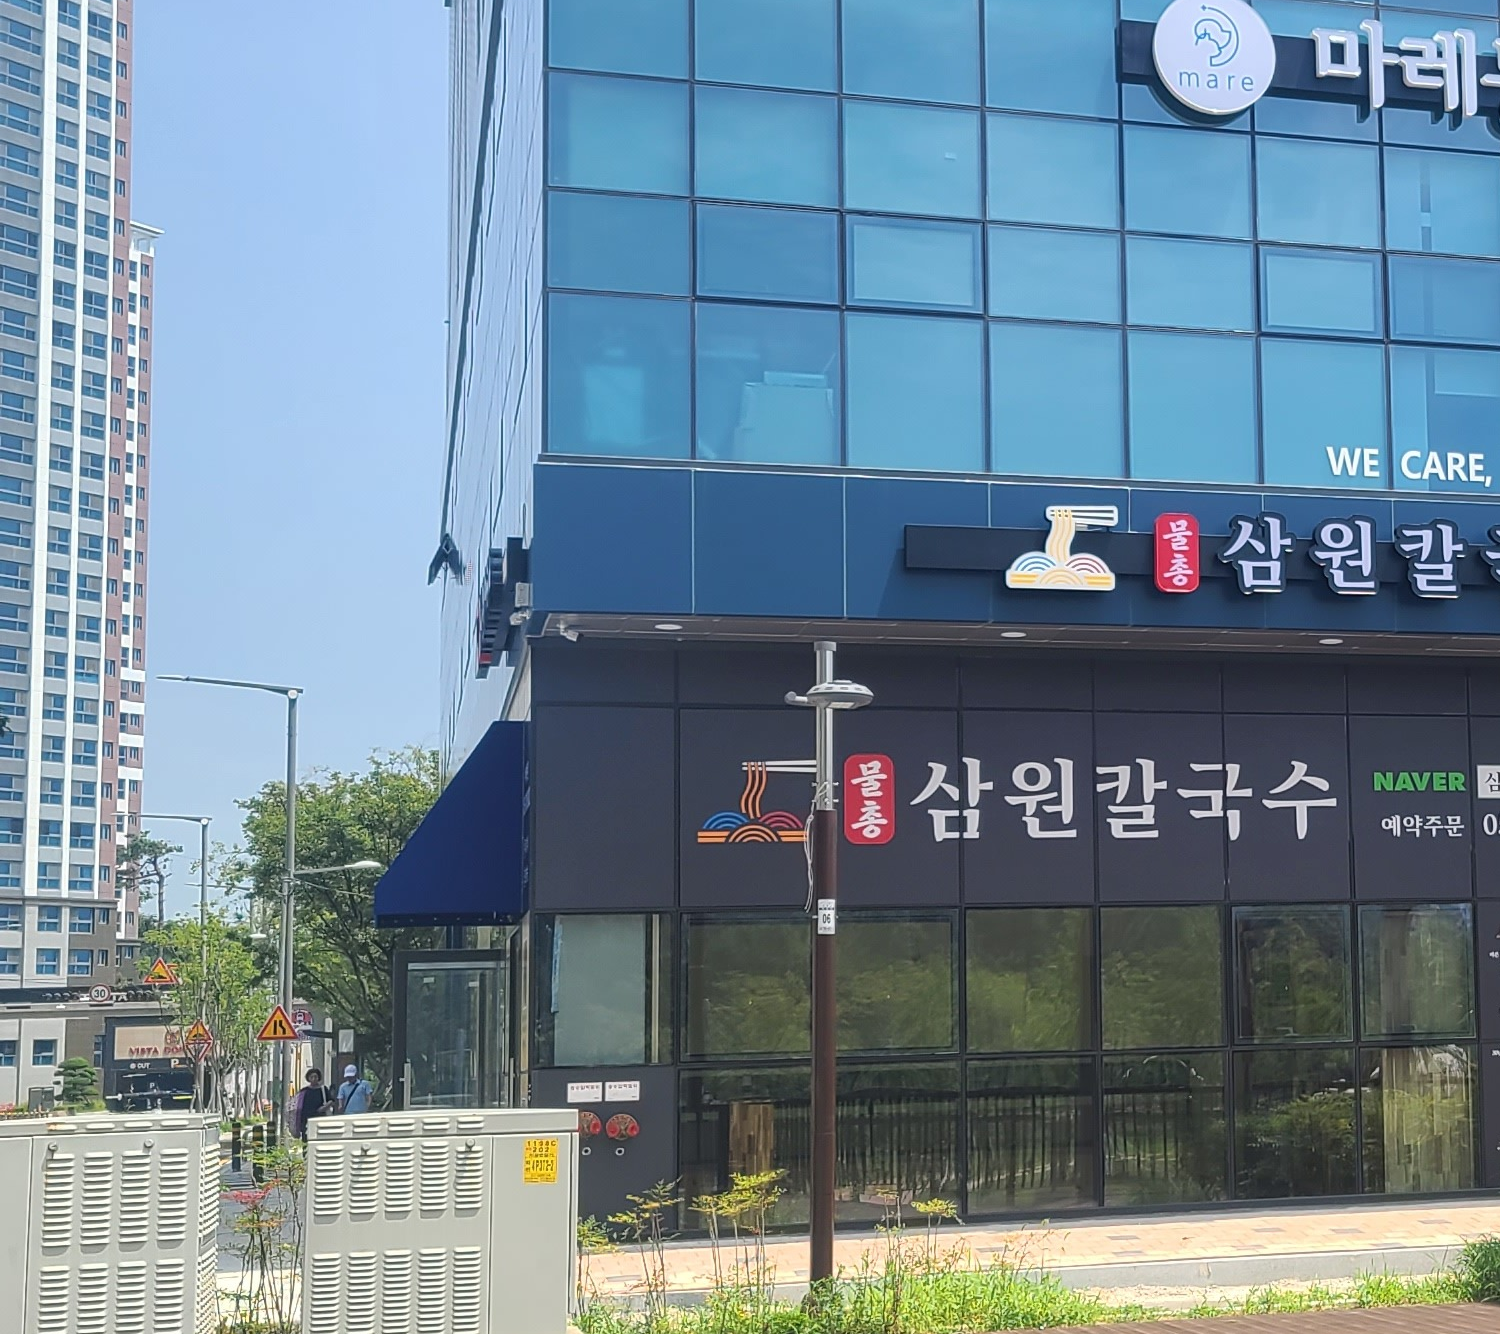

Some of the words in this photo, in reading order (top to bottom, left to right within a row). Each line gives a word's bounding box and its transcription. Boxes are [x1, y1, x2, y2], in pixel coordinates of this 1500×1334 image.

[1179, 71, 1254, 92] mare
[1326, 446, 1380, 478] WE
[1400, 450, 1492, 487] CARE,
[1161, 516, 1194, 587] 물총
[1373, 772, 1466, 791] NAVER
[851, 760, 888, 839] 물총
[909, 756, 1337, 842] 삼원칼국수
[1381, 814, 1464, 838] 예약주문
[94, 988, 106, 1000] 30
[129, 1046, 159, 1056] VISTA
